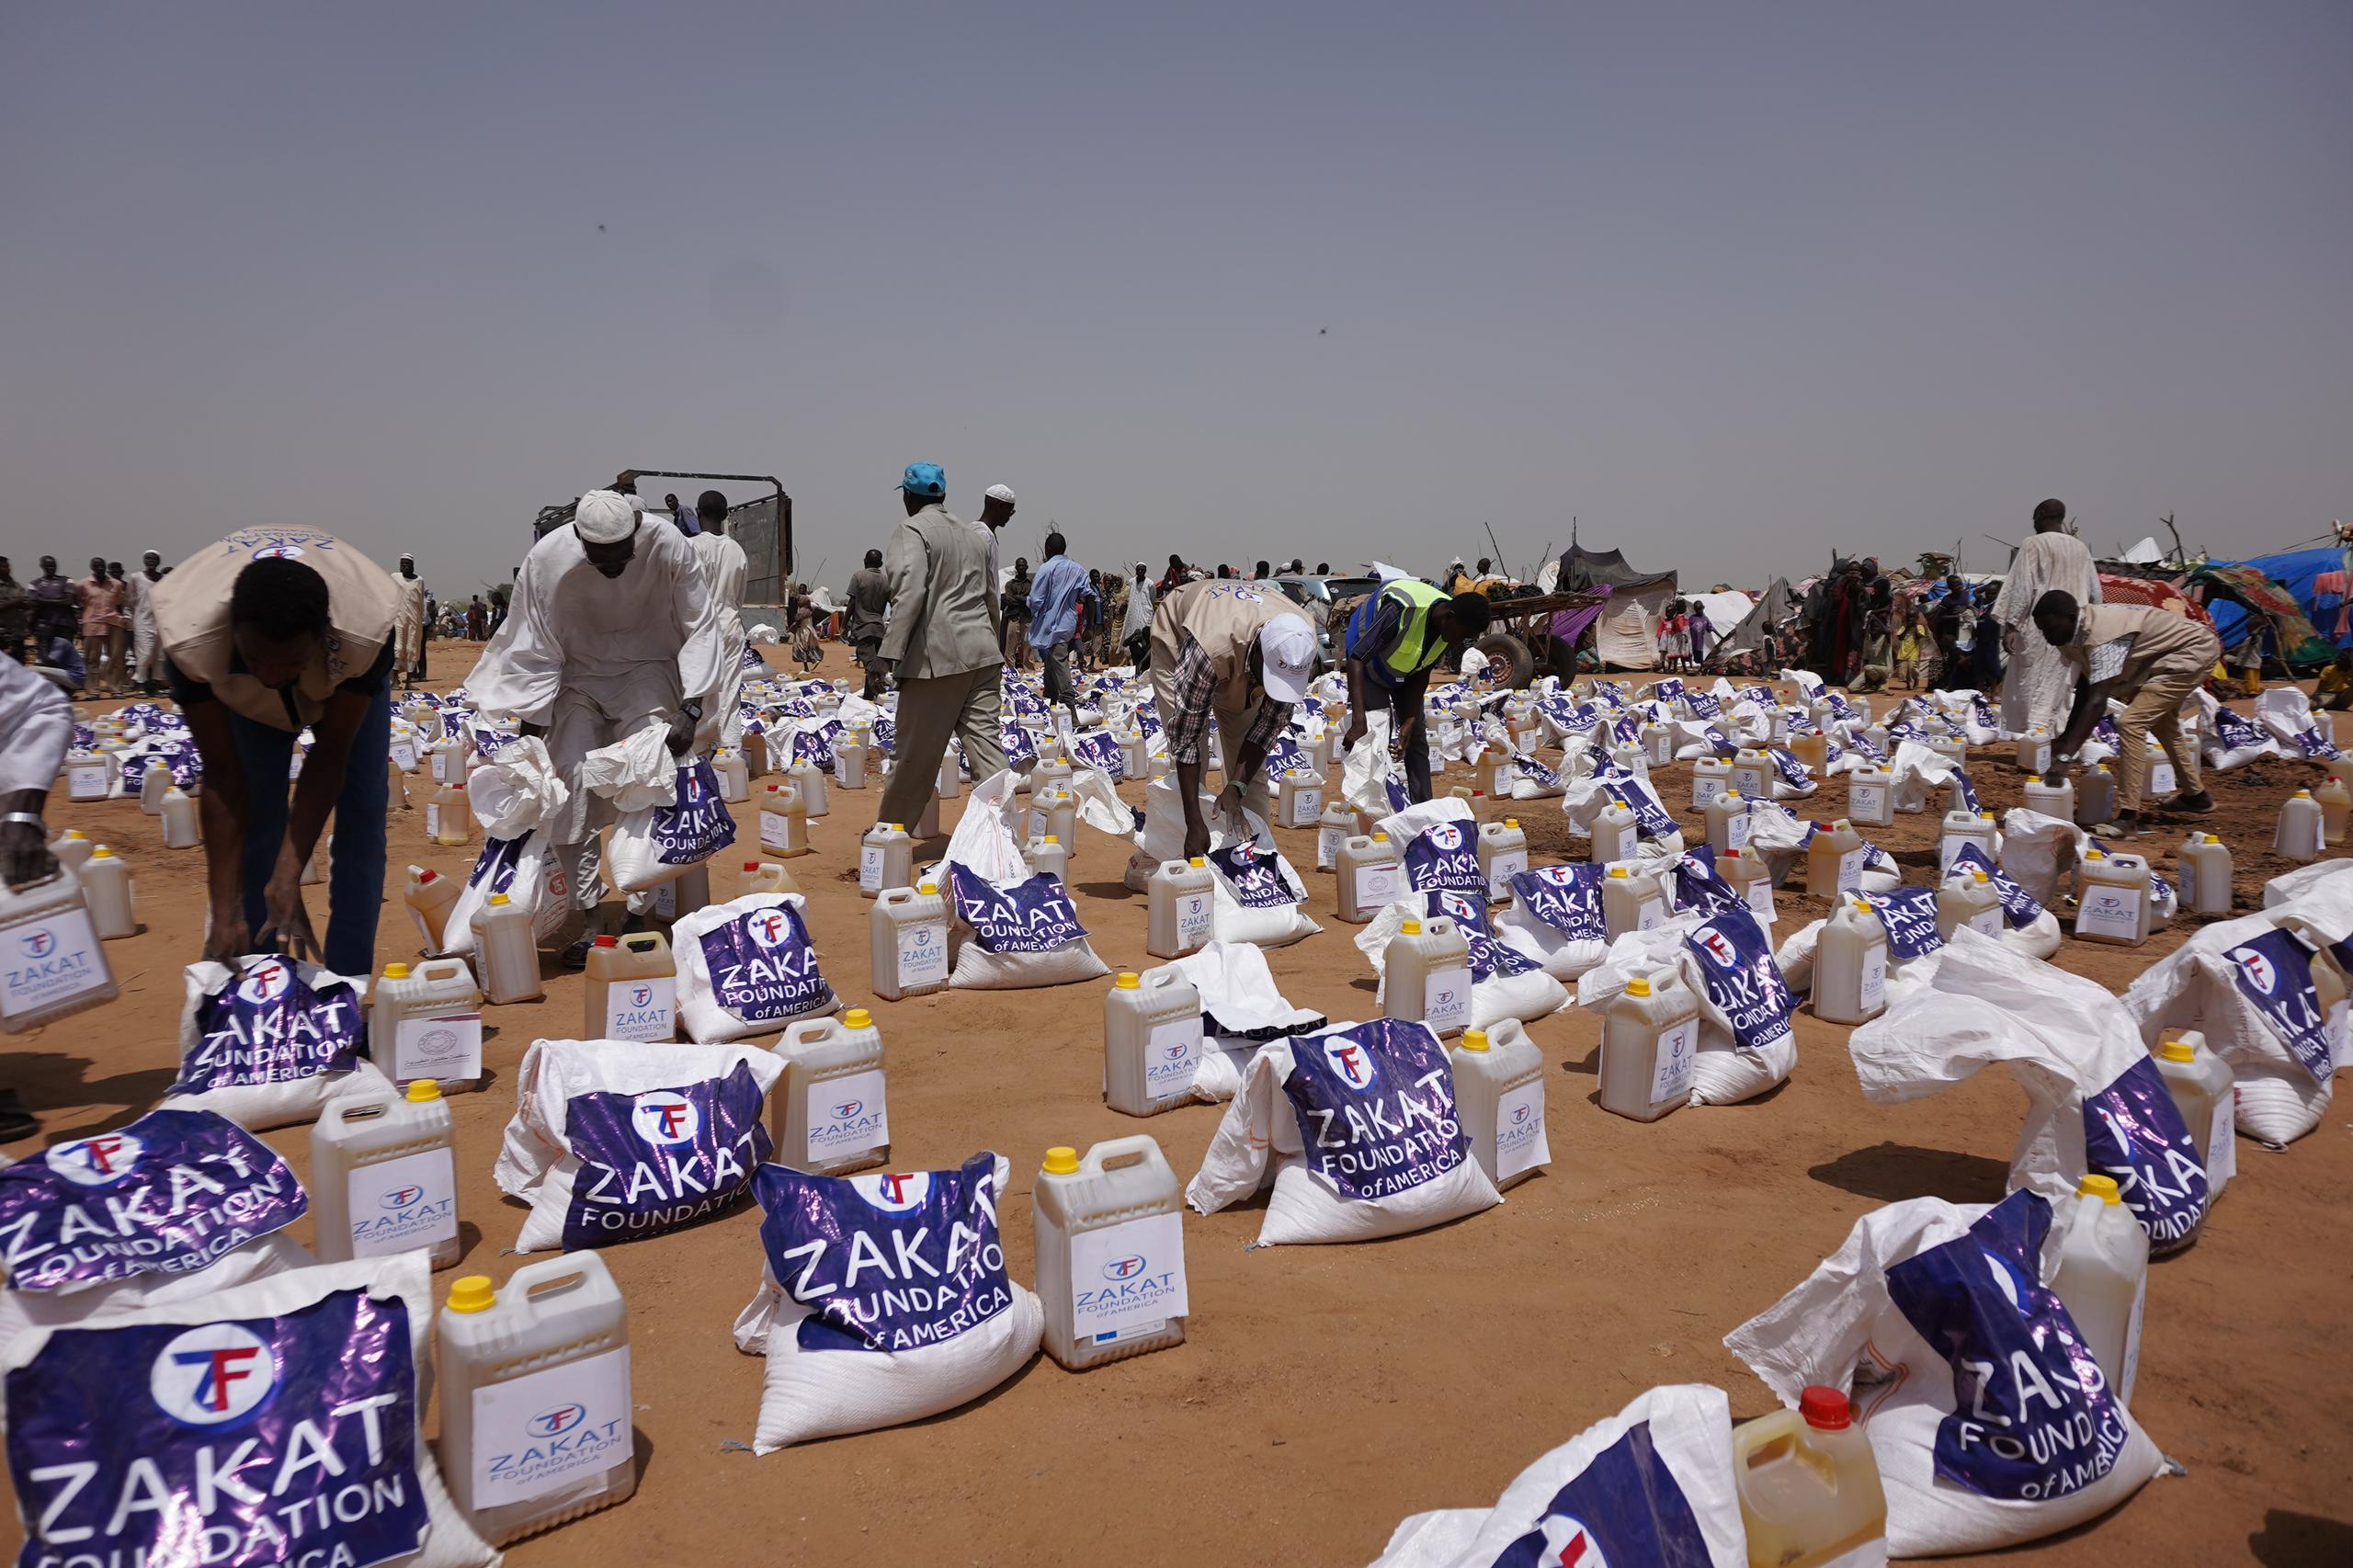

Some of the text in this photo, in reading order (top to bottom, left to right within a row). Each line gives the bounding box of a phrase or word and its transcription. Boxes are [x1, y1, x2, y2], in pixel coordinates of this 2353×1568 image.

[1693, 698, 1718, 711] ZAKA
[1266, 752, 1305, 777] ZAKAT
[1851, 798, 1877, 806] ZAKAT
[862, 865, 880, 874] ZAKAT
[1414, 854, 1479, 881] ZAKA
[1418, 876, 1486, 890] FOUNDATIO
[1527, 889, 1599, 915] ZAKA
[2084, 906, 2134, 917] ZAKAT
[1181, 914, 1211, 928] ZAKAT
[904, 946, 943, 962] ZAKAT
[995, 938, 1009, 952] of
[6, 950, 86, 989] ZAKAT
[719, 946, 817, 990] ZAKA
[904, 957, 943, 969] FOUNDATION
[11, 968, 91, 997] FOUNDATION
[725, 977, 827, 1006] FOUNDATI
[616, 1009, 667, 1027] ZAKAT
[756, 994, 827, 1020] of AMERICA
[1425, 1003, 1465, 1017] ZAKAT
[1427, 1010, 1465, 1021] OUNDATION
[194, 1002, 347, 1066] ZAKAT
[617, 1022, 667, 1034] FOUNDATION
[233, 1064, 329, 1085] AMERICA
[1147, 1057, 1200, 1077] ZAKAT
[1661, 1057, 1693, 1081] ZAKAT
[1306, 1068, 1454, 1149] ZAKAT
[810, 1112, 882, 1138] ZAKAT
[810, 1123, 882, 1144] FOUNDATION
[1497, 1118, 1541, 1145] ZAKAT
[1321, 1116, 1460, 1176] FOUNDATIO
[585, 1123, 758, 1204] ZAKAT
[1361, 1148, 1462, 1199] of AMERICA
[0, 1145, 252, 1267] ZAKAT
[353, 1198, 453, 1235] ZAKAT
[582, 1178, 751, 1231] FOUNDATIO
[15, 1174, 282, 1287] FOUNDATION
[353, 1210, 453, 1243] FOUNDATION
[387, 1223, 437, 1240] AMERICA
[784, 1174, 998, 1301] ZAKAT
[125, 1226, 253, 1275] AMERICA
[824, 1243, 1005, 1326] OUNDATIO
[1076, 1271, 1176, 1307] ZAKAT
[1078, 1286, 1176, 1315] FOUNDATION
[1108, 1299, 1159, 1317] AMERICA
[863, 1285, 1009, 1350] of AMERICA
[488, 1417, 622, 1473] ZAKAT
[1961, 1399, 2097, 1465] FOUND
[489, 1435, 621, 1483] FOUNDATION
[2022, 1405, 2130, 1499] of AMERICA
[29, 1392, 399, 1546] ZAKAT
[535, 1453, 601, 1482] AMERICA
